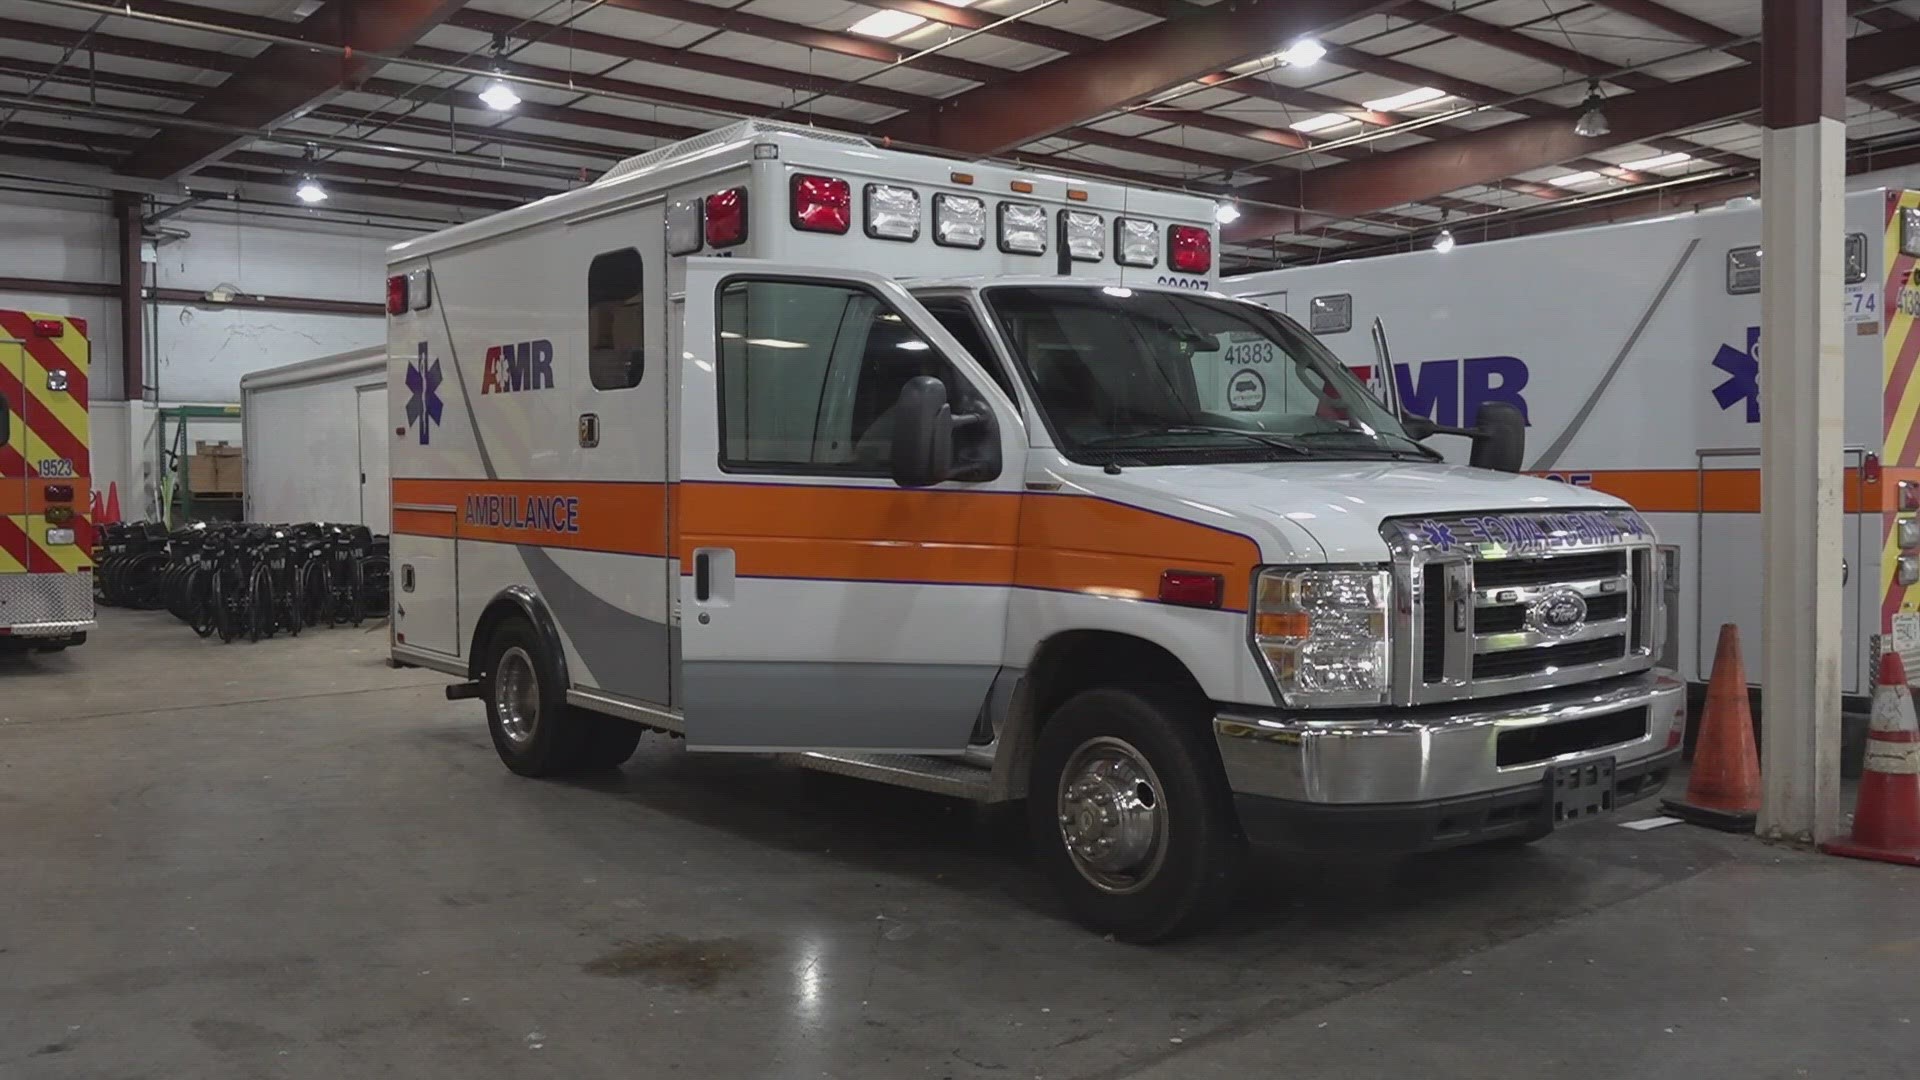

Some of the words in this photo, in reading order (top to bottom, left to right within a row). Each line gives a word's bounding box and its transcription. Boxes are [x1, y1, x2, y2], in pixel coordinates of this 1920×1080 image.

[481, 339, 555, 395] AMR
[1224, 343, 1274, 365] 41383
[38, 459, 73, 477] 19523
[464, 493, 580, 534] AMBULANCE
